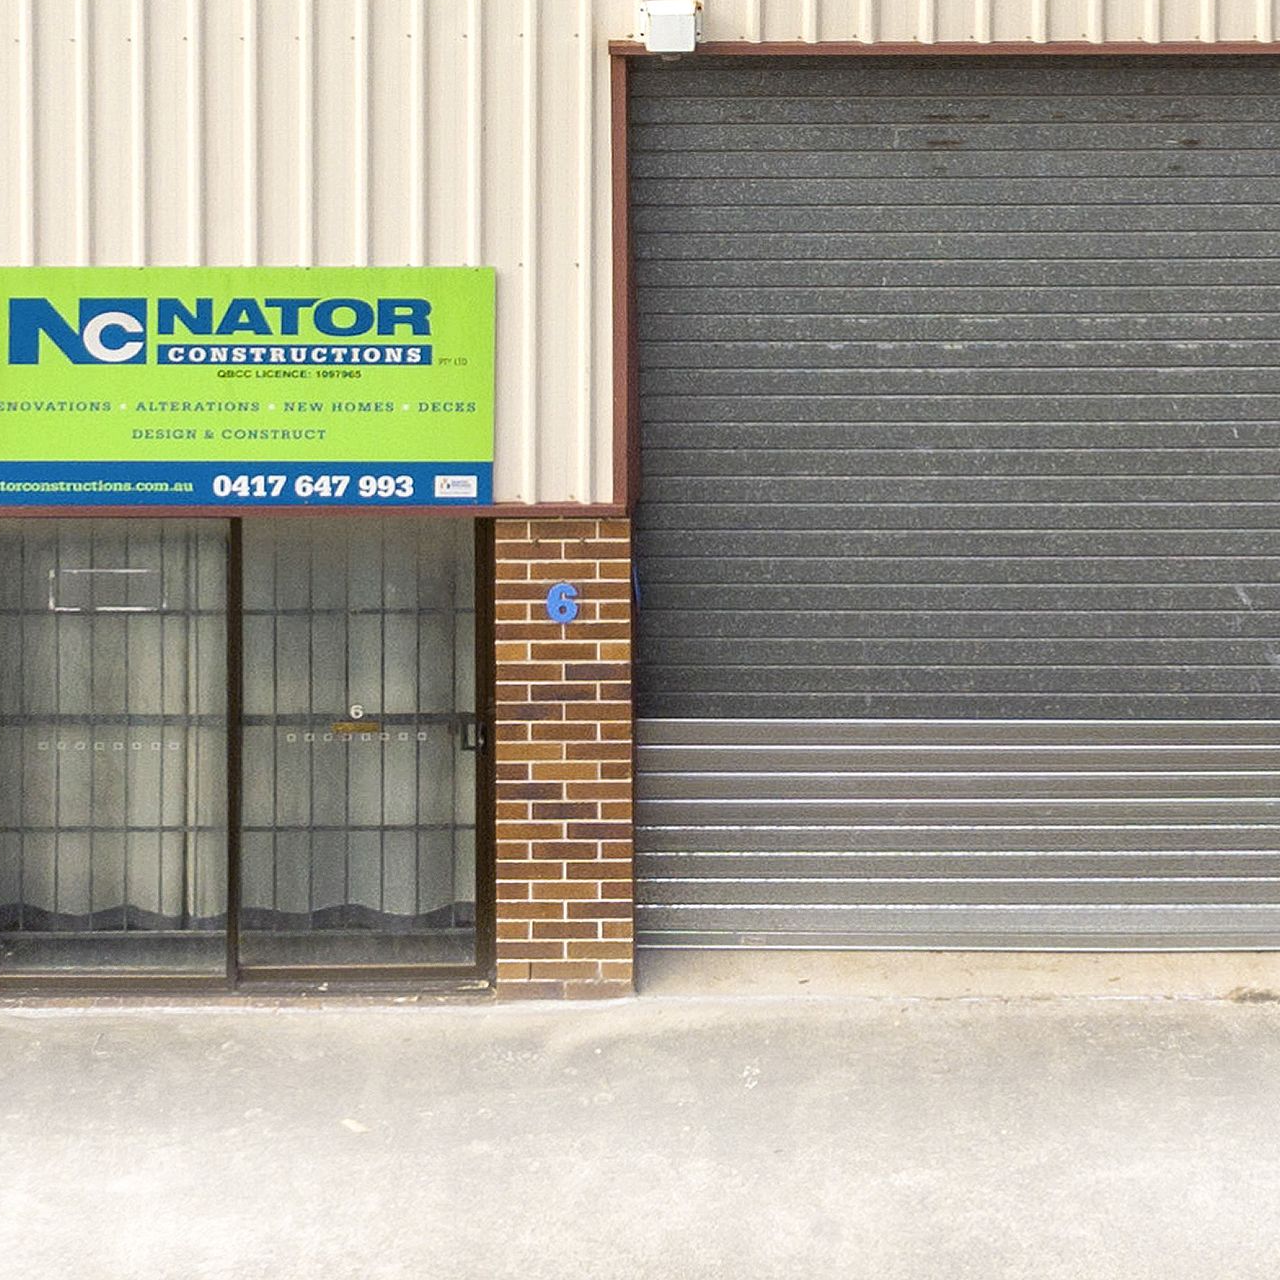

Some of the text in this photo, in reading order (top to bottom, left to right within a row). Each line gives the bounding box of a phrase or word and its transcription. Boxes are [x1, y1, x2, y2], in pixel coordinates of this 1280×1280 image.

[157, 298, 433, 337] NATOR
[9, 298, 147, 365] NC
[168, 347, 422, 363] CONSTRUCTIONS
[217, 369, 252, 379] QBCC
[136, 401, 261, 412] ALTERATIONS
[284, 401, 324, 413] NEW
[332, 401, 395, 413] HOMES
[132, 428, 327, 440] DESIGN & CONSTRUCT
[212, 475, 287, 497] 0417
[294, 475, 351, 497] 647
[358, 475, 414, 497] 993
[547, 581, 579, 624] 6
[350, 704, 364, 719] 6
